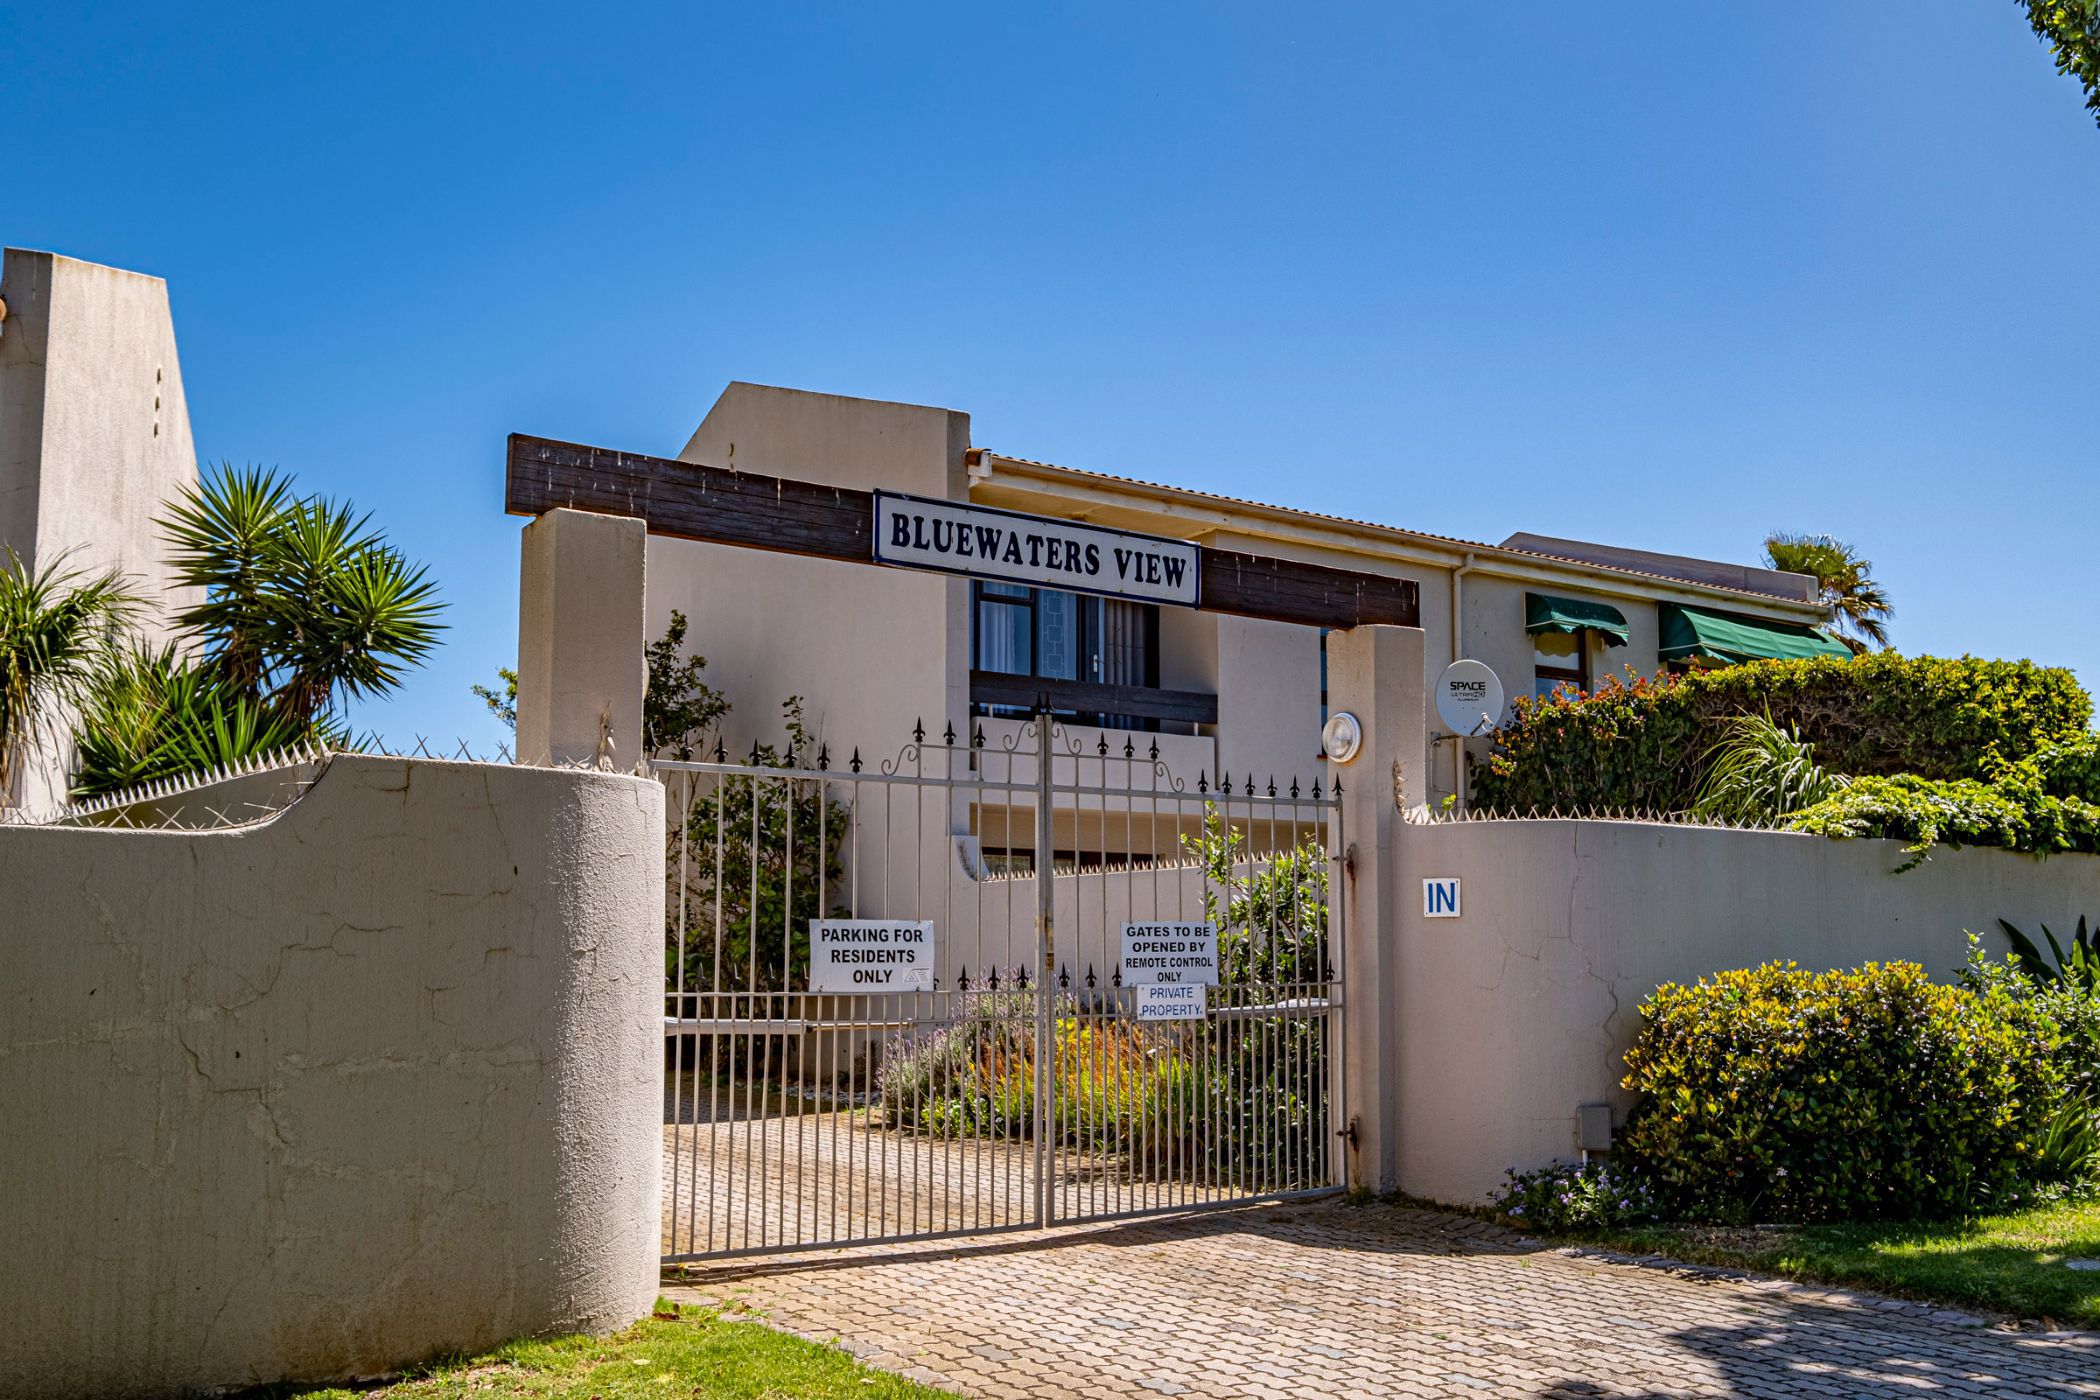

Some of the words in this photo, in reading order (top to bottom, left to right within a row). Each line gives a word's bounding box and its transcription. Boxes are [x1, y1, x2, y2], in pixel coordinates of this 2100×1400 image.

[890, 512, 1100, 576] BLUEWATERS
[1113, 548, 1187, 588] VIEW
[1450, 681, 1486, 691] SPACE
[1428, 883, 1455, 912] IN
[821, 928, 889, 942] PARKING
[894, 929, 923, 942] FOR
[1126, 926, 1170, 937] GATES
[1173, 927, 1190, 937] TO
[1194, 927, 1210, 936] BE
[1132, 942, 1185, 952] OPENED
[1189, 942, 1206, 952] BY
[831, 949, 915, 963] RESIDENTS
[1126, 958, 1167, 968] REMOTE
[1169, 957, 1213, 967] CONTROL
[853, 970, 893, 983] ONLY
[1157, 972, 1182, 982] ONLY
[1150, 987, 1193, 999] PRIVATE
[1142, 1004, 1200, 1017] PROPERTY
